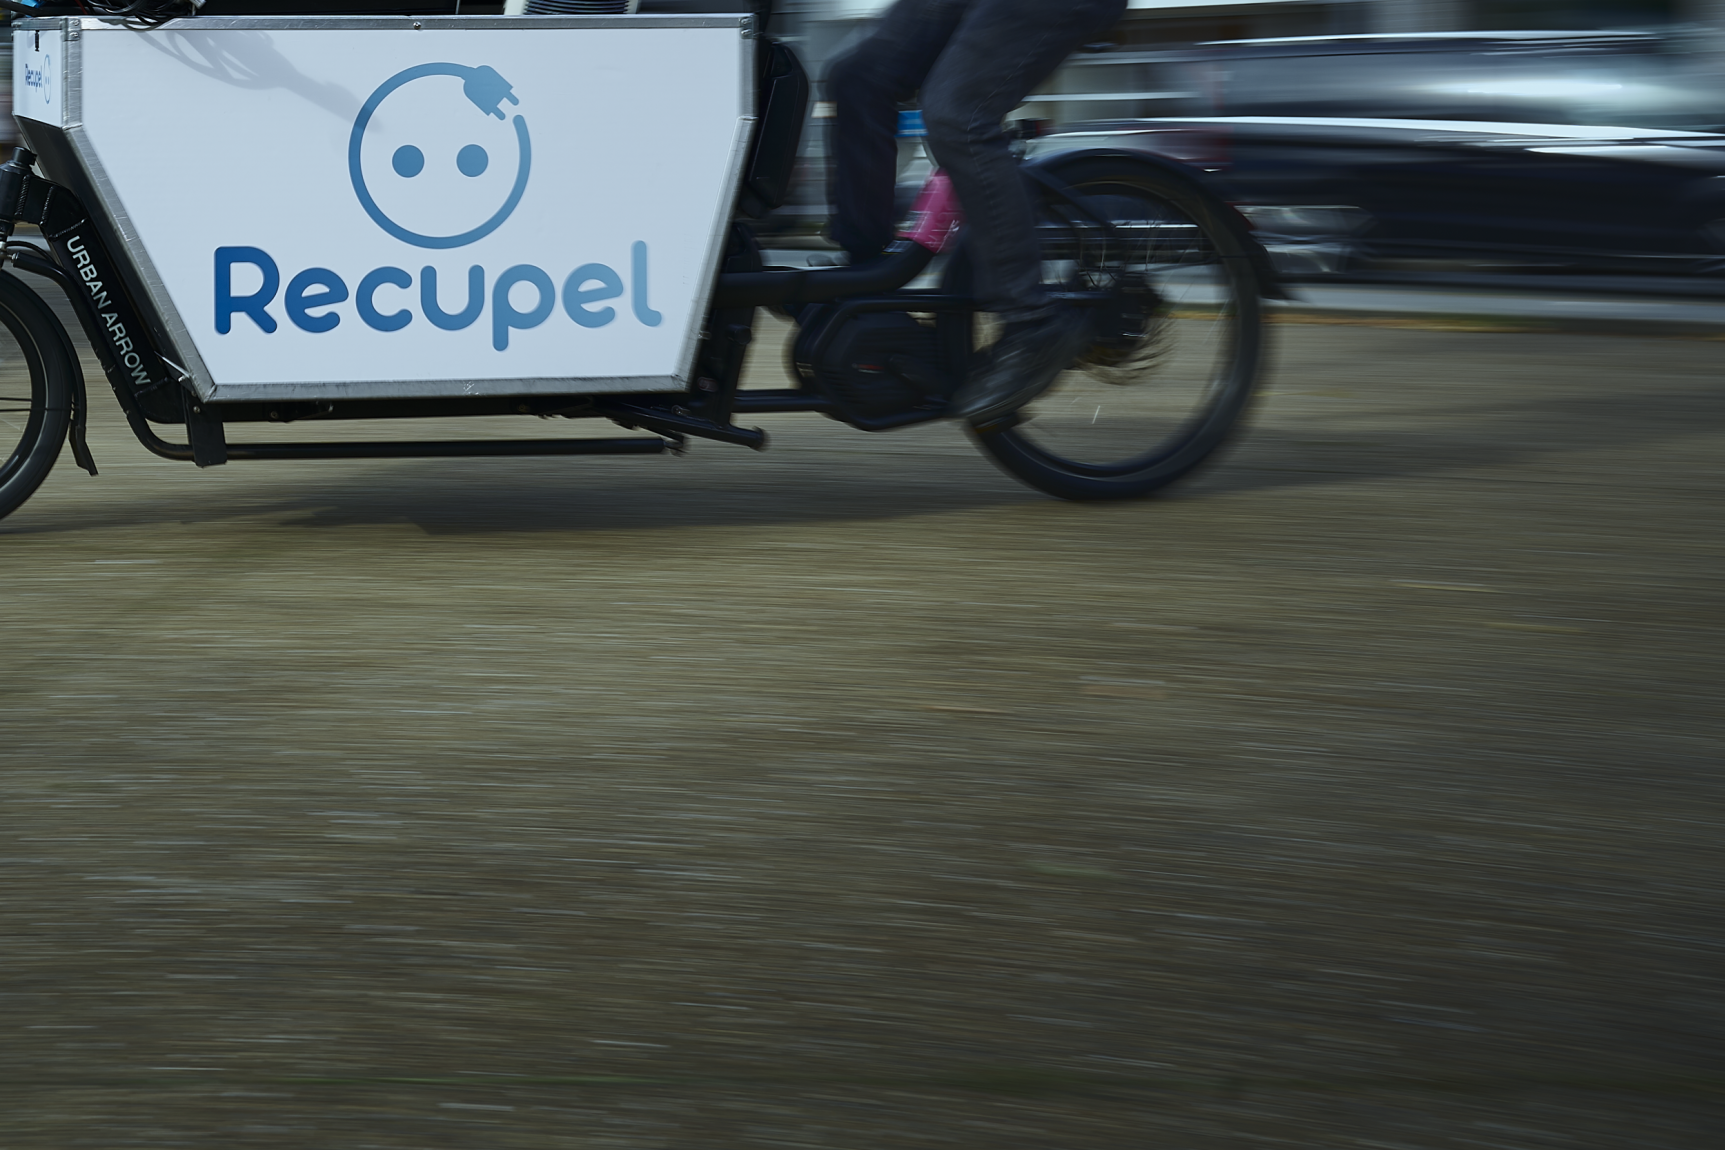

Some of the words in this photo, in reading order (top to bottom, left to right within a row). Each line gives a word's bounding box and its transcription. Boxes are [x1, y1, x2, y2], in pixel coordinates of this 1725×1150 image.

[24, 63, 43, 93] Recupel
[66, 235, 112, 310] URBAN
[101, 312, 151, 386] ARROW
[214, 239, 663, 352] Recupel
